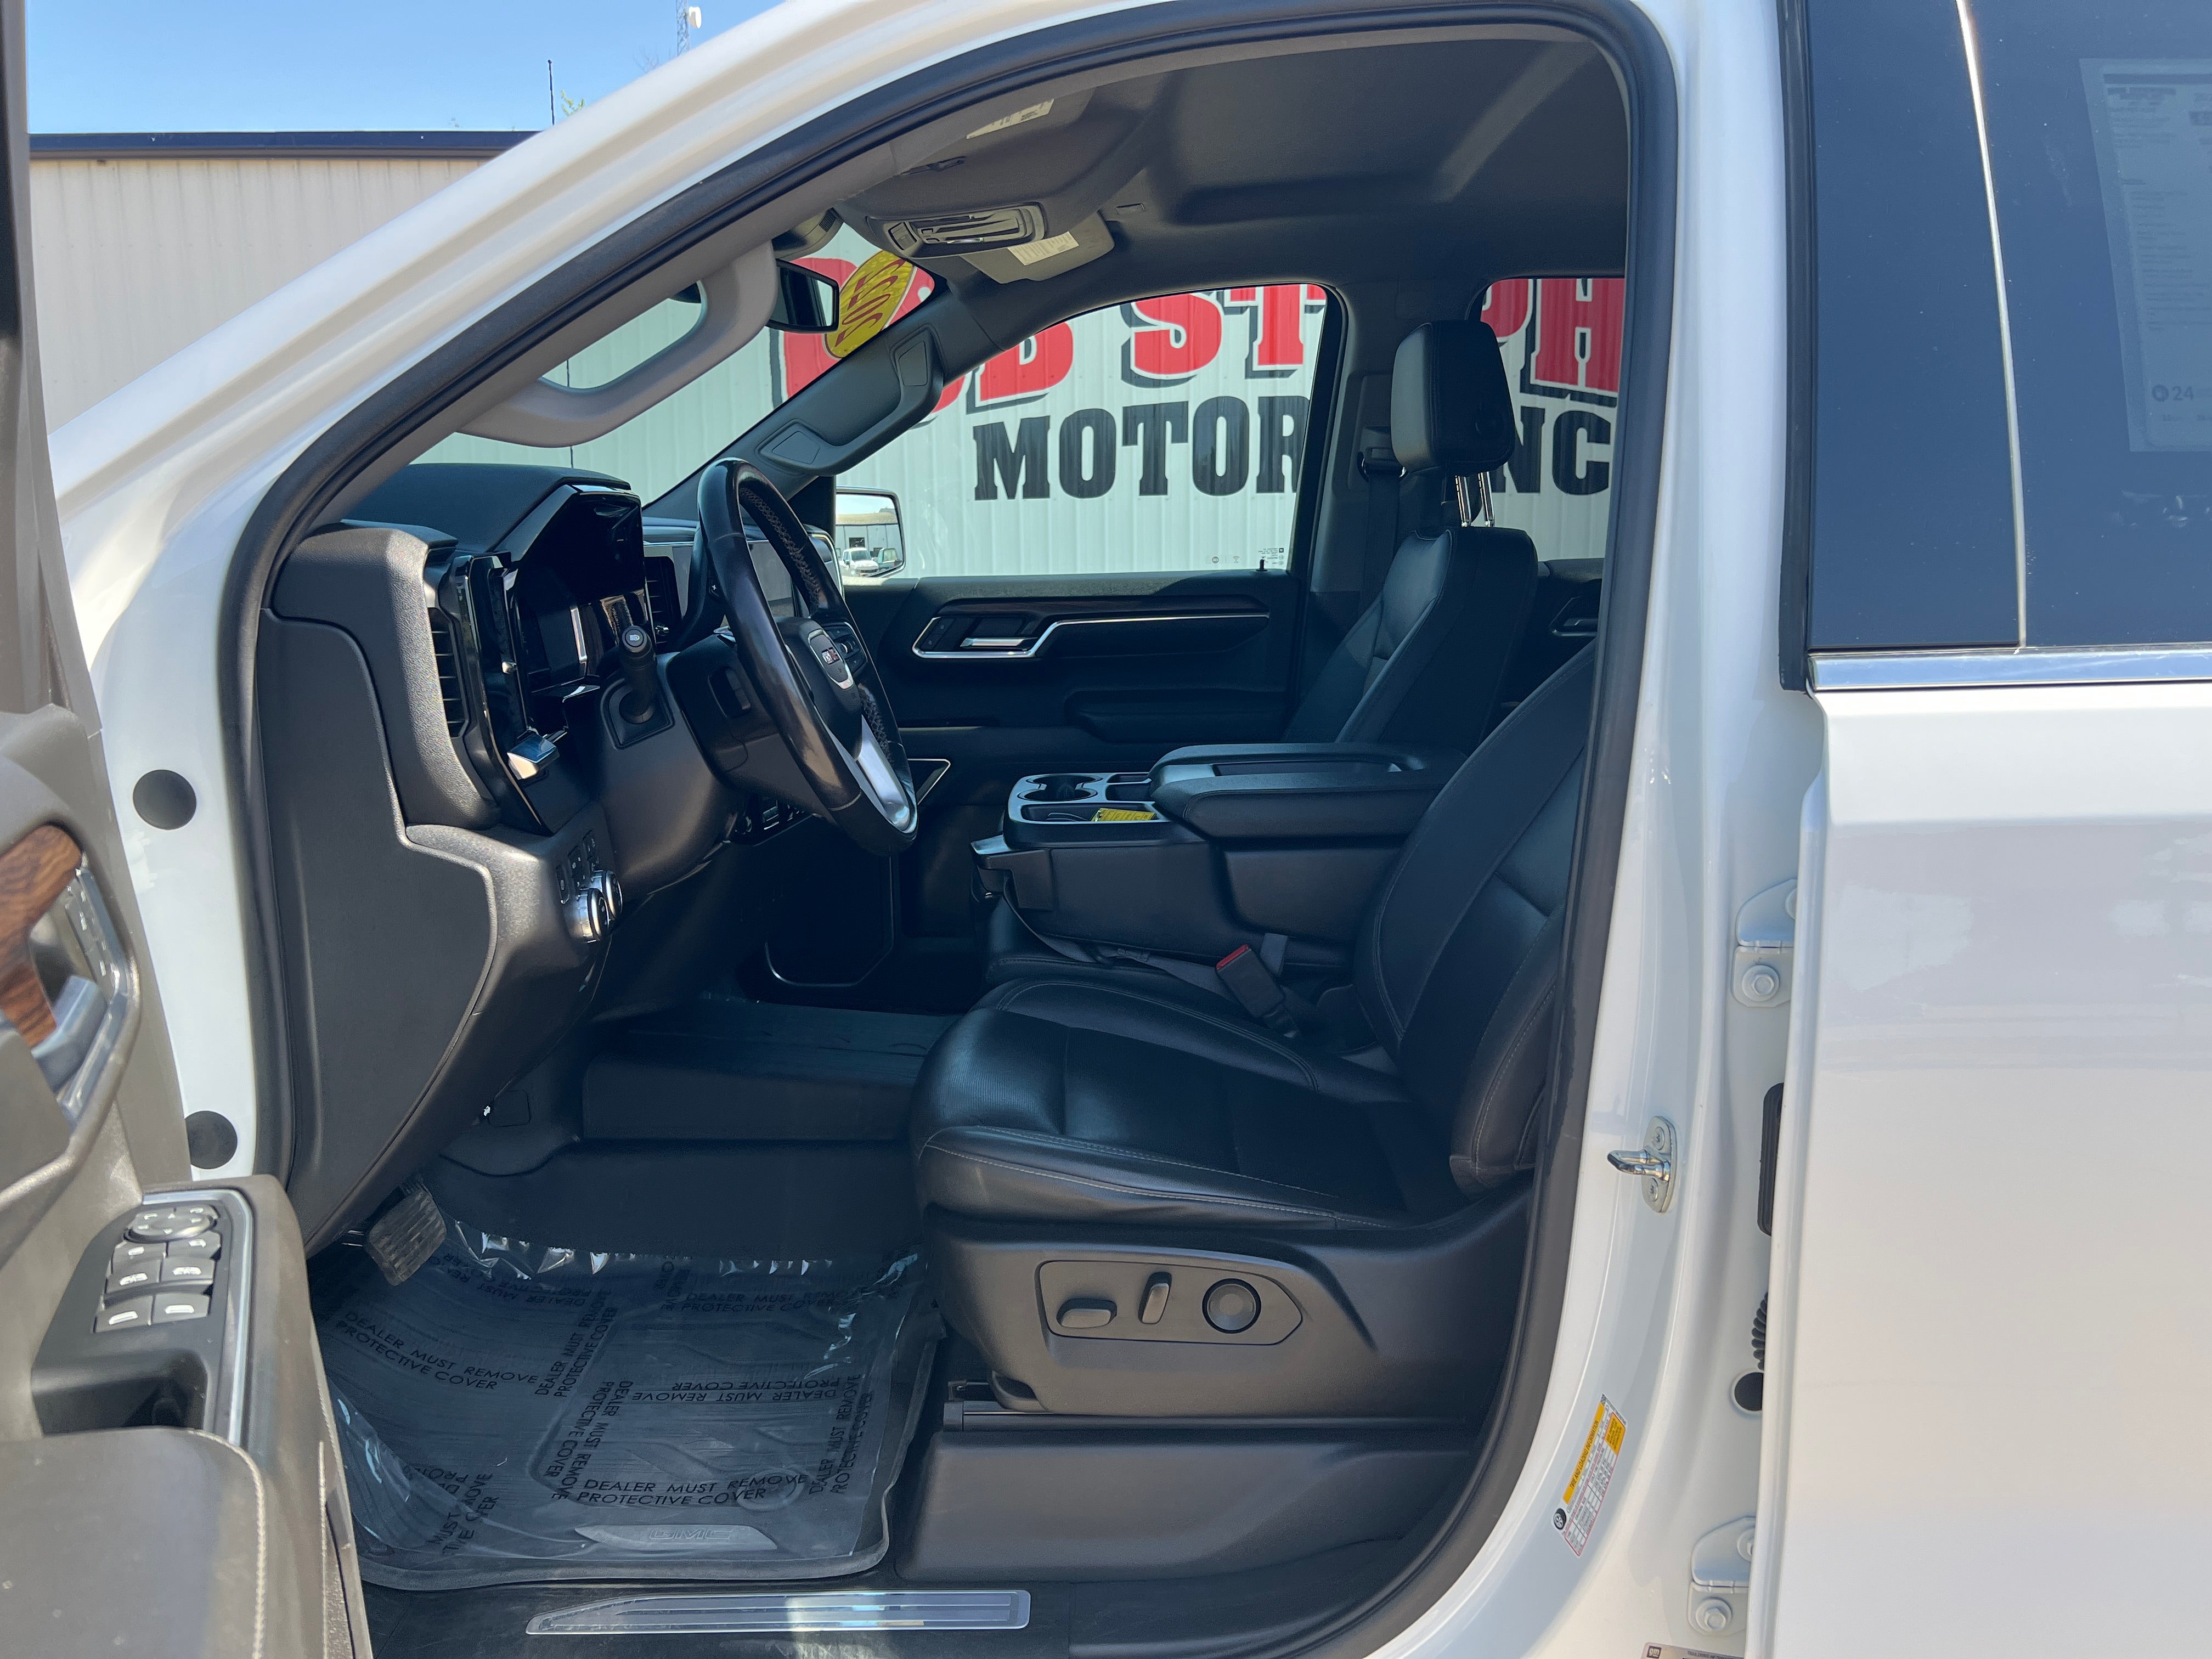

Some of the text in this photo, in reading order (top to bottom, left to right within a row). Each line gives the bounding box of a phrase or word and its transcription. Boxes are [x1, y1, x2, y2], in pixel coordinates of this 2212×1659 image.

[681, 1302, 777, 1312] PROTECTIVE
[686, 1293, 745, 1302] DEALER
[755, 1293, 794, 1302] MUST
[335, 1320, 498, 1390] PROTECTIVE COVER
[345, 1311, 538, 1385] DEALER MUST REMOVE
[534, 1361, 567, 1395] DEALER
[561, 1332, 585, 1356] MUST
[553, 1342, 599, 1397] PROTECTIVE
[672, 1378, 840, 1391] PROTECTIVE COVER
[631, 1390, 836, 1402] DEALER MUST REMOVE
[543, 1381, 614, 1477] PROTECTIVE COVER
[551, 1381, 633, 1500] DEALER MUST REMOVE
[809, 1458, 834, 1494] DEALER
[836, 1374, 861, 1420] REMOVE
[577, 1487, 767, 1505] PROTECTIVE COVER
[583, 1474, 809, 1493] DEALER MUST REMOVE
[649, 1526, 733, 1541] GMC
